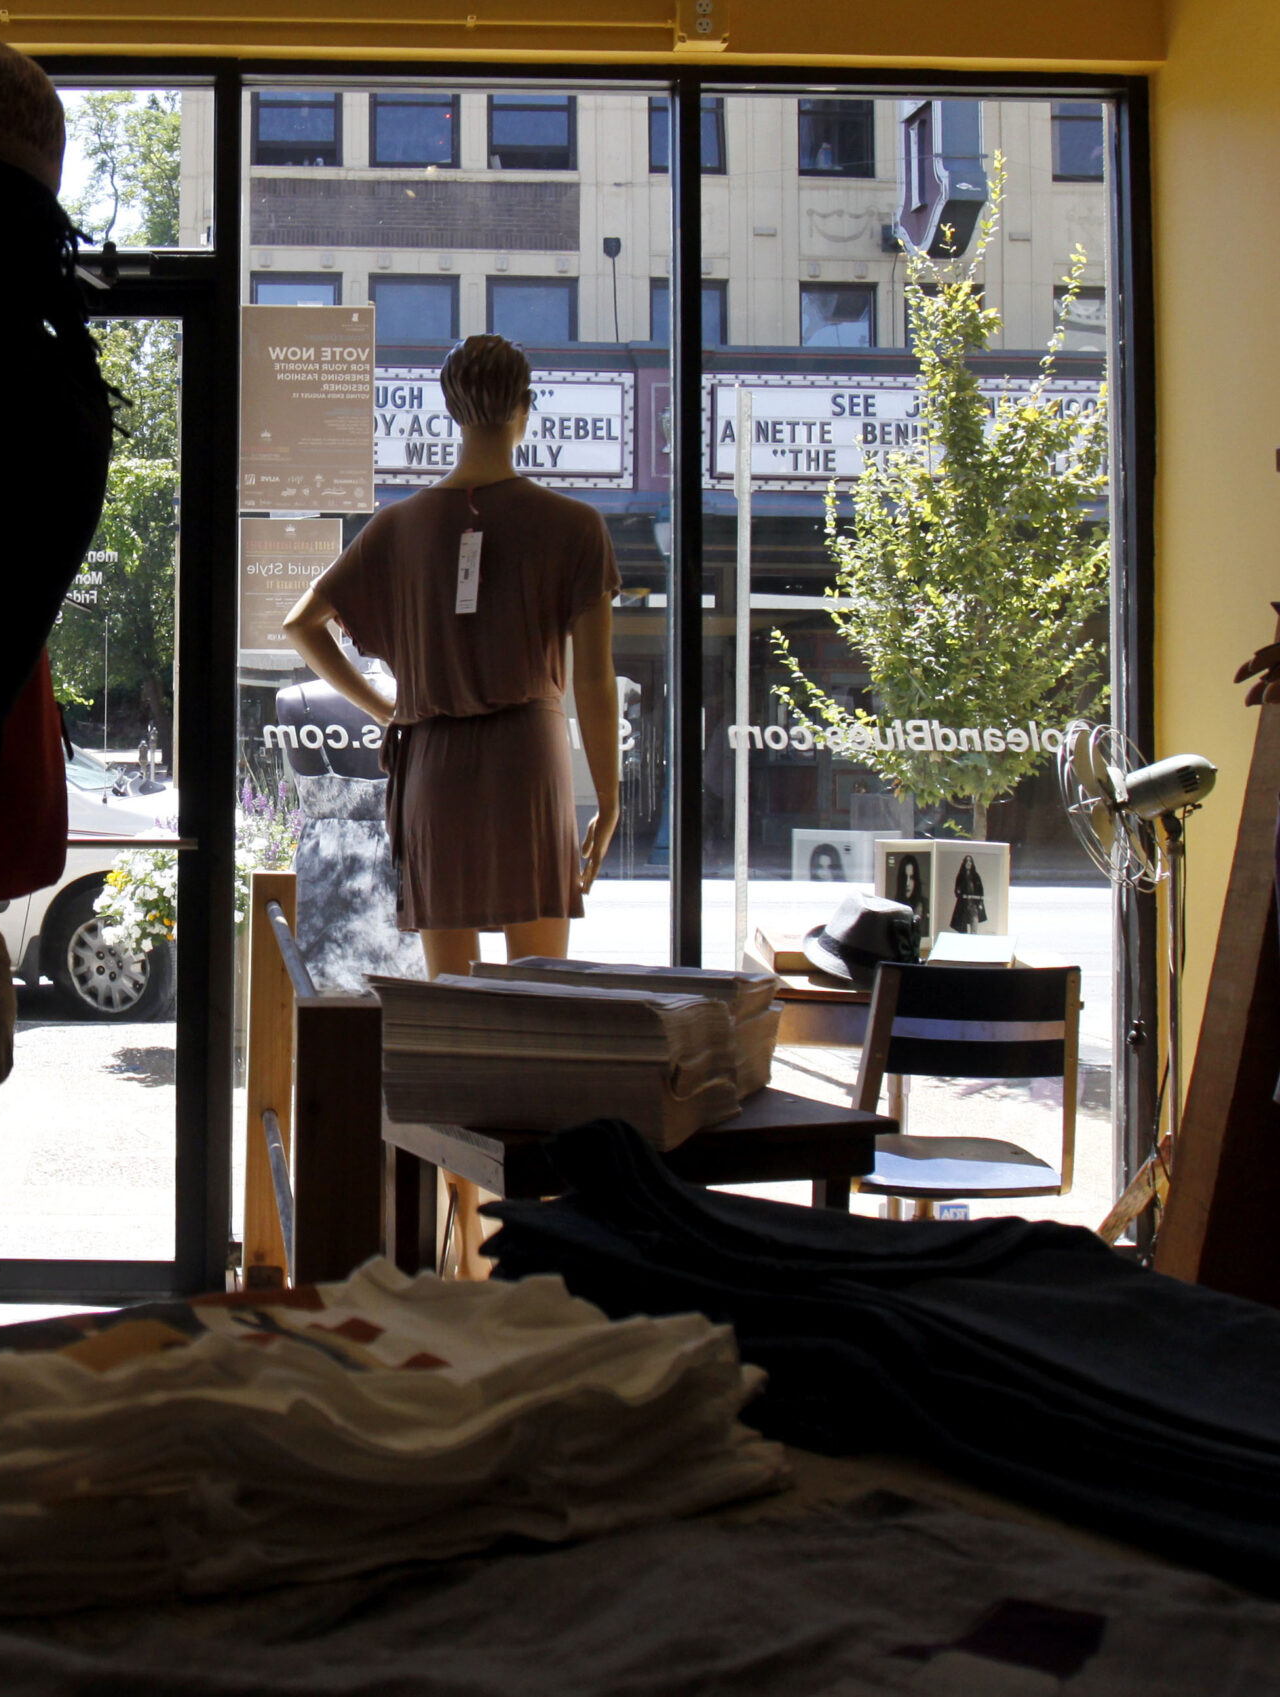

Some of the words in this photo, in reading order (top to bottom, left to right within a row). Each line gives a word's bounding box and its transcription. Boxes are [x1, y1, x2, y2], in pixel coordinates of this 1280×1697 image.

[375, 386, 423, 410] UGH
[831, 393, 877, 417] SEE
[720, 420, 833, 444] ANETTE
[404, 442, 462, 466] WEE
[514, 444, 563, 468] NLY
